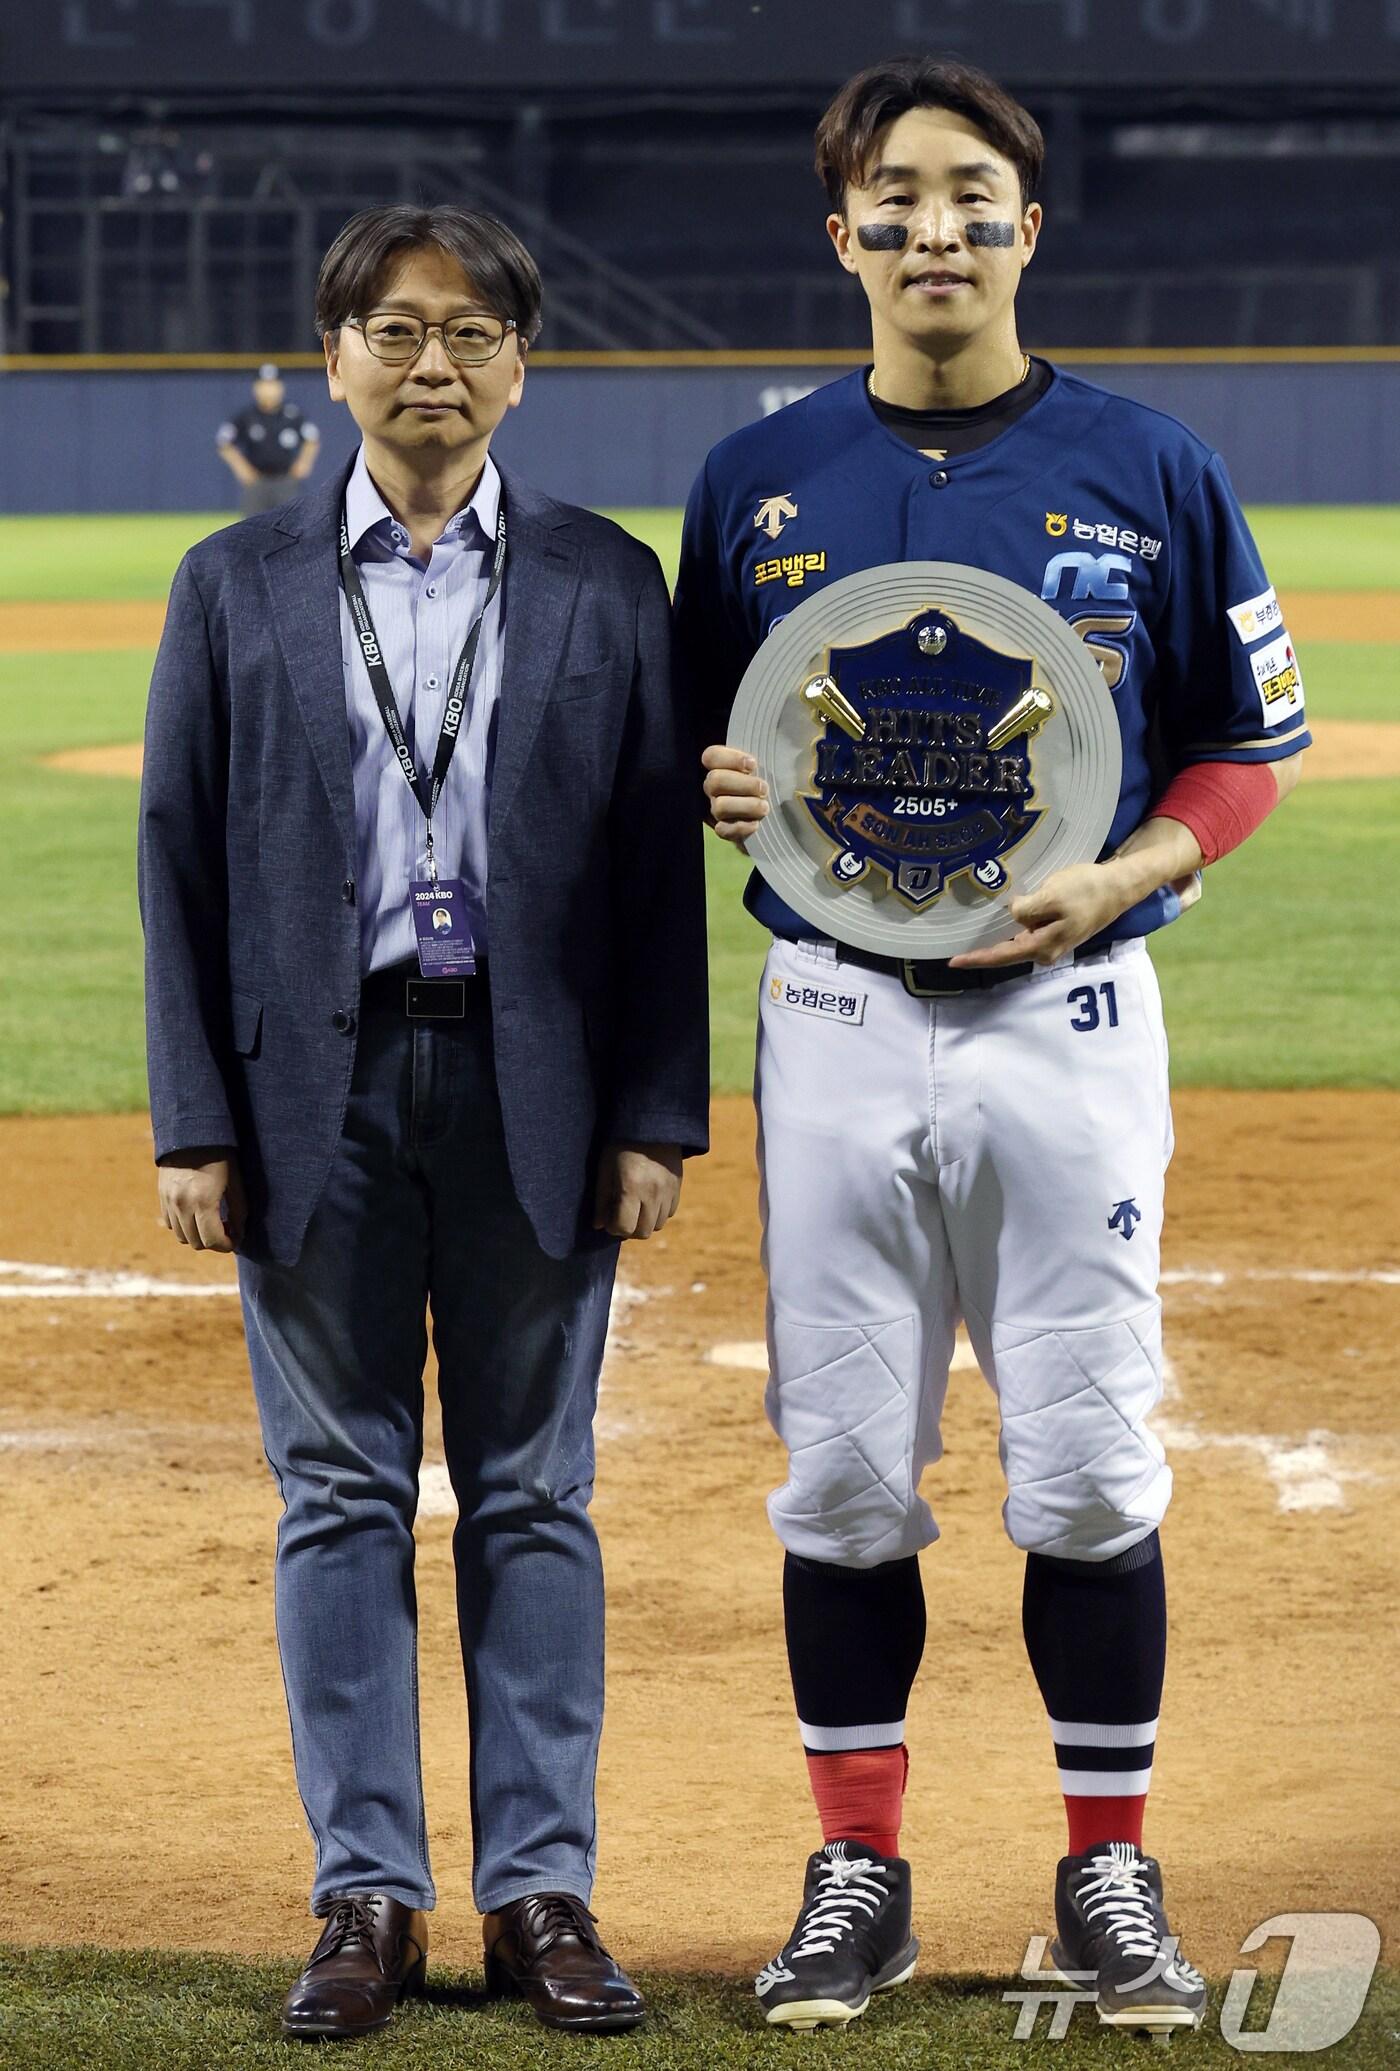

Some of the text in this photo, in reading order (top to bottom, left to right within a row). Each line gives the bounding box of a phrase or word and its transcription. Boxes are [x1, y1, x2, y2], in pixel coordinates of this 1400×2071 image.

[1072, 518, 1162, 561] 농협은행
[754, 551, 826, 587] 포크밸리
[360, 631, 382, 667] KBO
[442, 697, 463, 737] KBO
[396, 745, 418, 782] KBO
[817, 744, 1029, 793] LEADER
[893, 796, 958, 816] 2505+
[415, 891, 453, 901] 2024 KBO
[784, 983, 858, 1017] 농협은행
[1066, 981, 1120, 1032] 31
